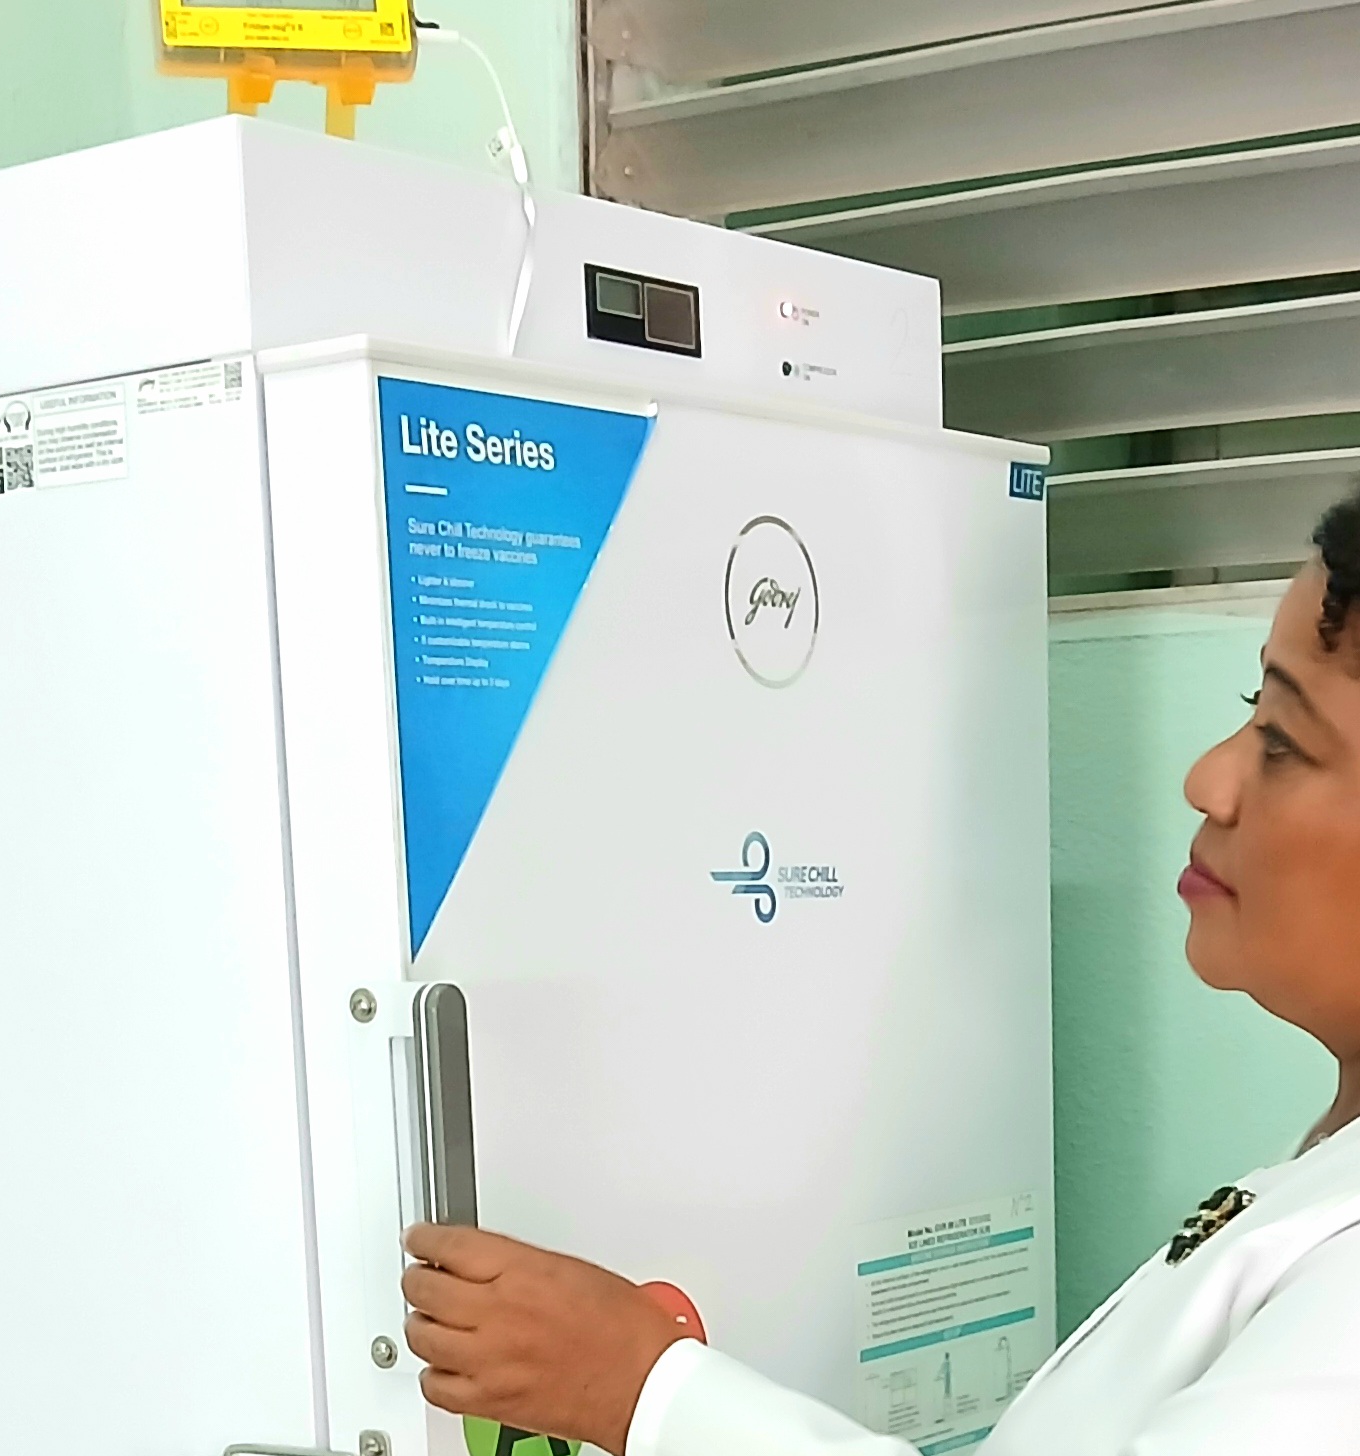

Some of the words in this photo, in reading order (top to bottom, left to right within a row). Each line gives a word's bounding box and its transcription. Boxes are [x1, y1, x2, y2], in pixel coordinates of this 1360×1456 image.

[400, 413, 458, 459] Lite
[465, 422, 556, 472] Series
[1012, 467, 1043, 496] LITE
[407, 516, 436, 536] Sure
[437, 519, 463, 538] Chill
[463, 521, 525, 547] Technology
[409, 541, 442, 557] never
[443, 542, 456, 559] to
[778, 865, 807, 883] SURE
[808, 865, 839, 883] CHILL
